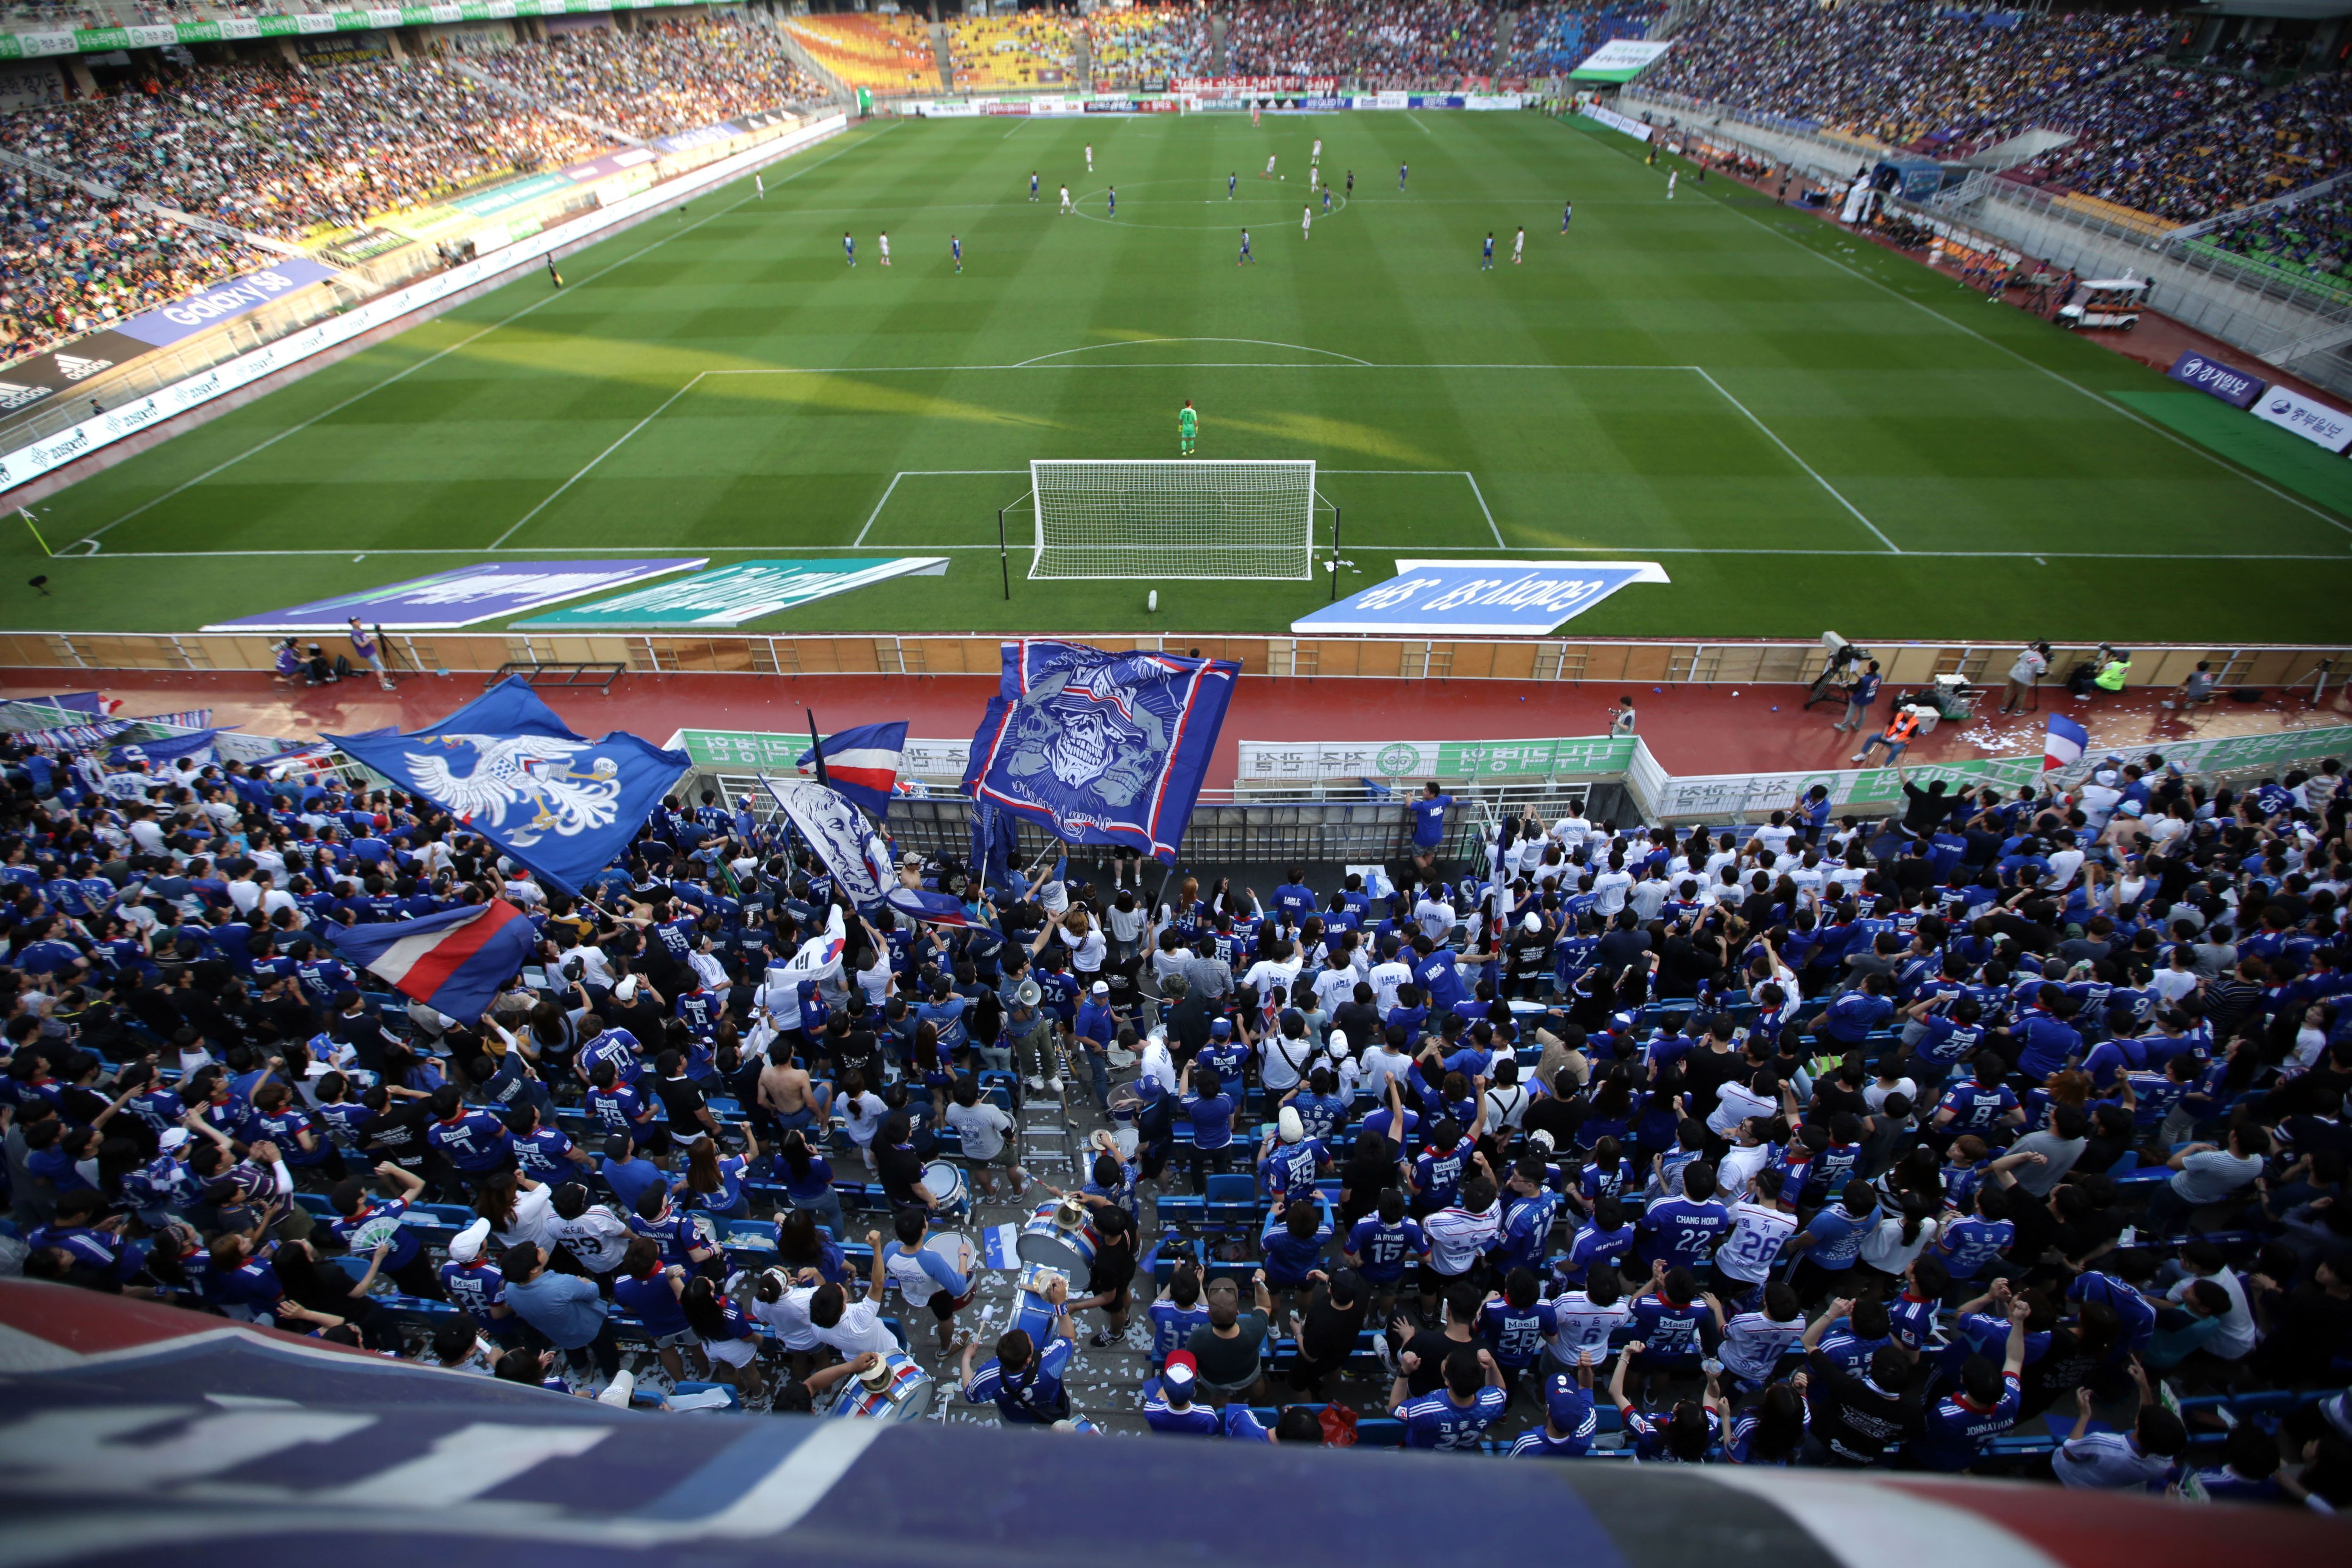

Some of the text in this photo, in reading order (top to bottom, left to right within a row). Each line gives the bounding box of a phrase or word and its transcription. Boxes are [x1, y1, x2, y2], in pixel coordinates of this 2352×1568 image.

[1317, 98, 1336, 107] QLED
[1337, 98, 1346, 107] TV
[164, 271, 294, 325] Galaxy S8
[66, 359, 113, 380] adidas
[2200, 364, 2250, 396] 경기일보
[2, 386, 54, 409] adidas
[2290, 407, 2344, 439] 중부일보
[1473, 572, 1604, 612] Galaxy
[115, 783, 135, 795] 22
[2259, 794, 2282, 813] 26
[701, 818, 717, 831] 14
[819, 886, 832, 904] 7
[1575, 951, 1589, 965] 7
[1041, 985, 1064, 1003] 26
[695, 1008, 707, 1024] 6
[1953, 1032, 1976, 1042] Maeil
[599, 1041, 620, 1056] Maeil
[1975, 1096, 1998, 1105] Maeil
[444, 1129, 470, 1142] Maeil
[1302, 1119, 1331, 1138] 22
[452, 1139, 478, 1155] 7
[515, 1142, 538, 1153] Maeil
[1290, 1152, 1311, 1169] Maeil
[1436, 1160, 1459, 1171] Maeil
[1829, 1156, 1852, 1165] Maeil
[1677, 1215, 1718, 1225] CHANG HOON
[638, 1229, 674, 1240] JOHNATHAN
[1675, 1229, 1711, 1252] 22
[564, 1237, 602, 1256] 29
[1371, 1243, 1403, 1263] 15
[1595, 1239, 1623, 1252] HERBALIFE
[1739, 1231, 1780, 1263] 26
[1959, 1243, 2002, 1261] 22
[453, 1279, 479, 1292] Maeil
[1508, 1318, 1537, 1329] Maeil
[1663, 1320, 1692, 1330] Maeil
[1582, 1327, 1601, 1345] 6
[1441, 1420, 1487, 1433] 고종수
[1965, 1416, 2015, 1436] JOHNATHAN
[1437, 1430, 1482, 1452] 22
